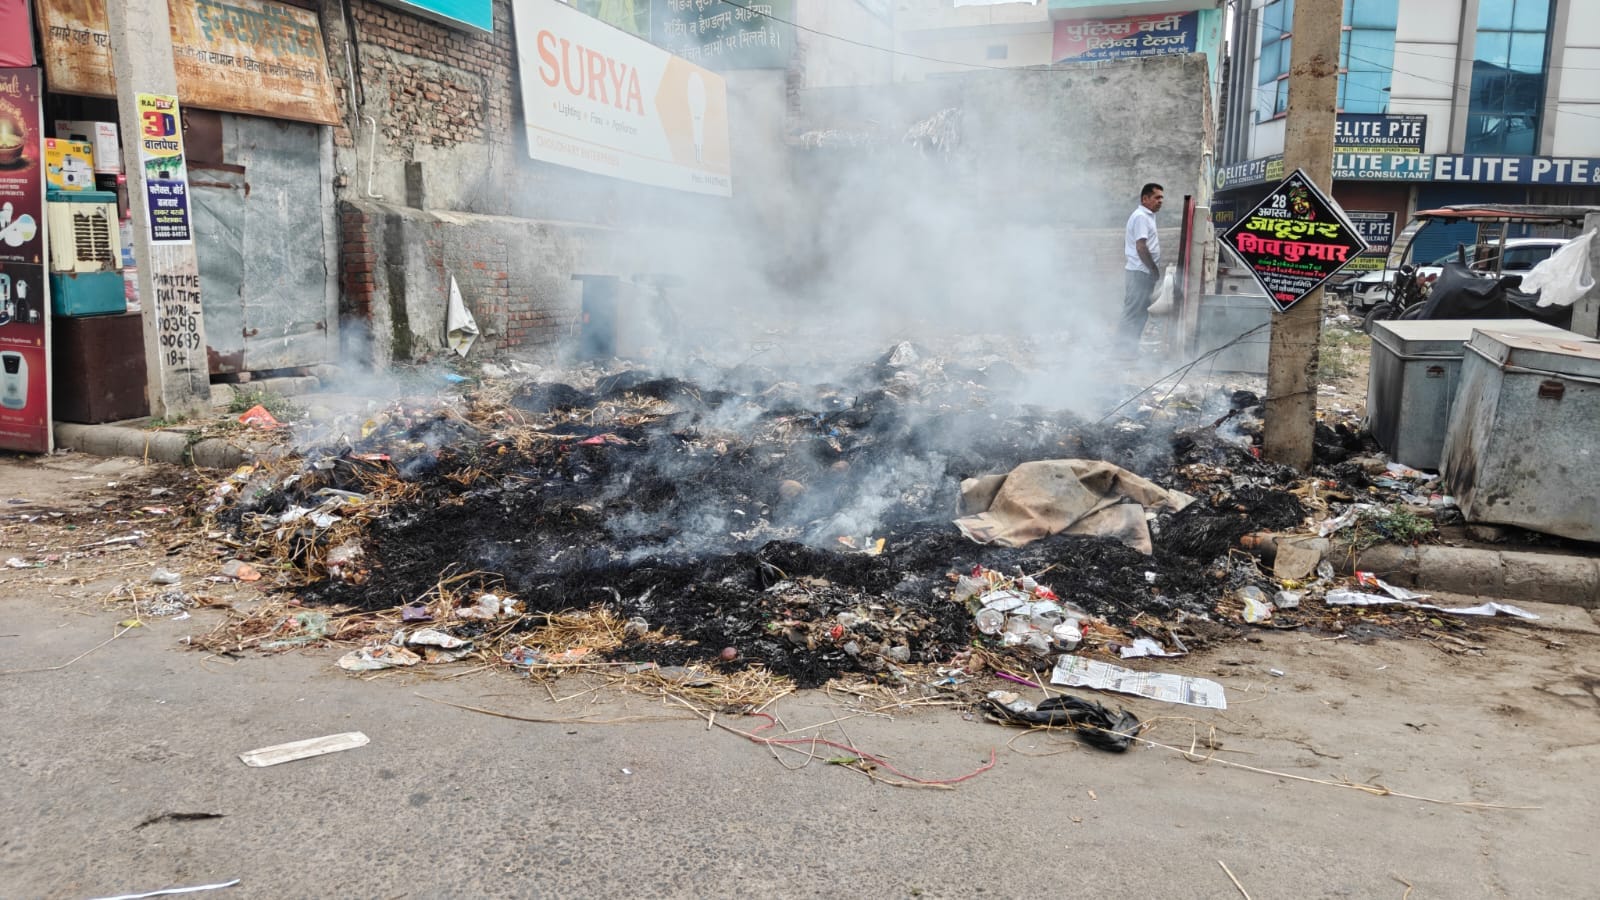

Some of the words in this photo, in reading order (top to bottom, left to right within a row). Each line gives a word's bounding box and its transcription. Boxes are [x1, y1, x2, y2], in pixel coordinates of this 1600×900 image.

[1066, 21, 1131, 42] पुलिस
[1137, 15, 1182, 31] वर्दी
[726, 36, 737, 49] पर
[739, 28, 767, 48] मिलती
[93, 32, 107, 47] पर
[208, 51, 234, 67] सामान
[537, 29, 645, 116] SURYA
[141, 99, 155, 107] RAJ
[558, 101, 582, 121] Lighting
[143, 111, 176, 137] 3D
[1336, 121, 1381, 137] ELITE
[1389, 122, 1421, 137] PTE
[144, 138, 178, 151] वालपेपर
[1226, 164, 1248, 179] ELITE
[1250, 160, 1266, 177] PTE
[1333, 154, 1382, 170] LITE
[1391, 155, 1431, 171] PTE
[1434, 156, 1520, 181] ELITE
[1531, 158, 1589, 183] PTE
[1332, 170, 1355, 178] VISA
[1359, 170, 1430, 179] CONSULTANT
[1272, 195, 1287, 208] 28
[1258, 208, 1287, 218] अगस्त
[1246, 217, 1340, 240] जादूगर
[1370, 222, 1391, 235] PTE
[1368, 245, 1388, 253] RARY
[157, 288, 174, 304] FULL
[177, 289, 200, 304] TIME
[167, 350, 186, 366] 18+
